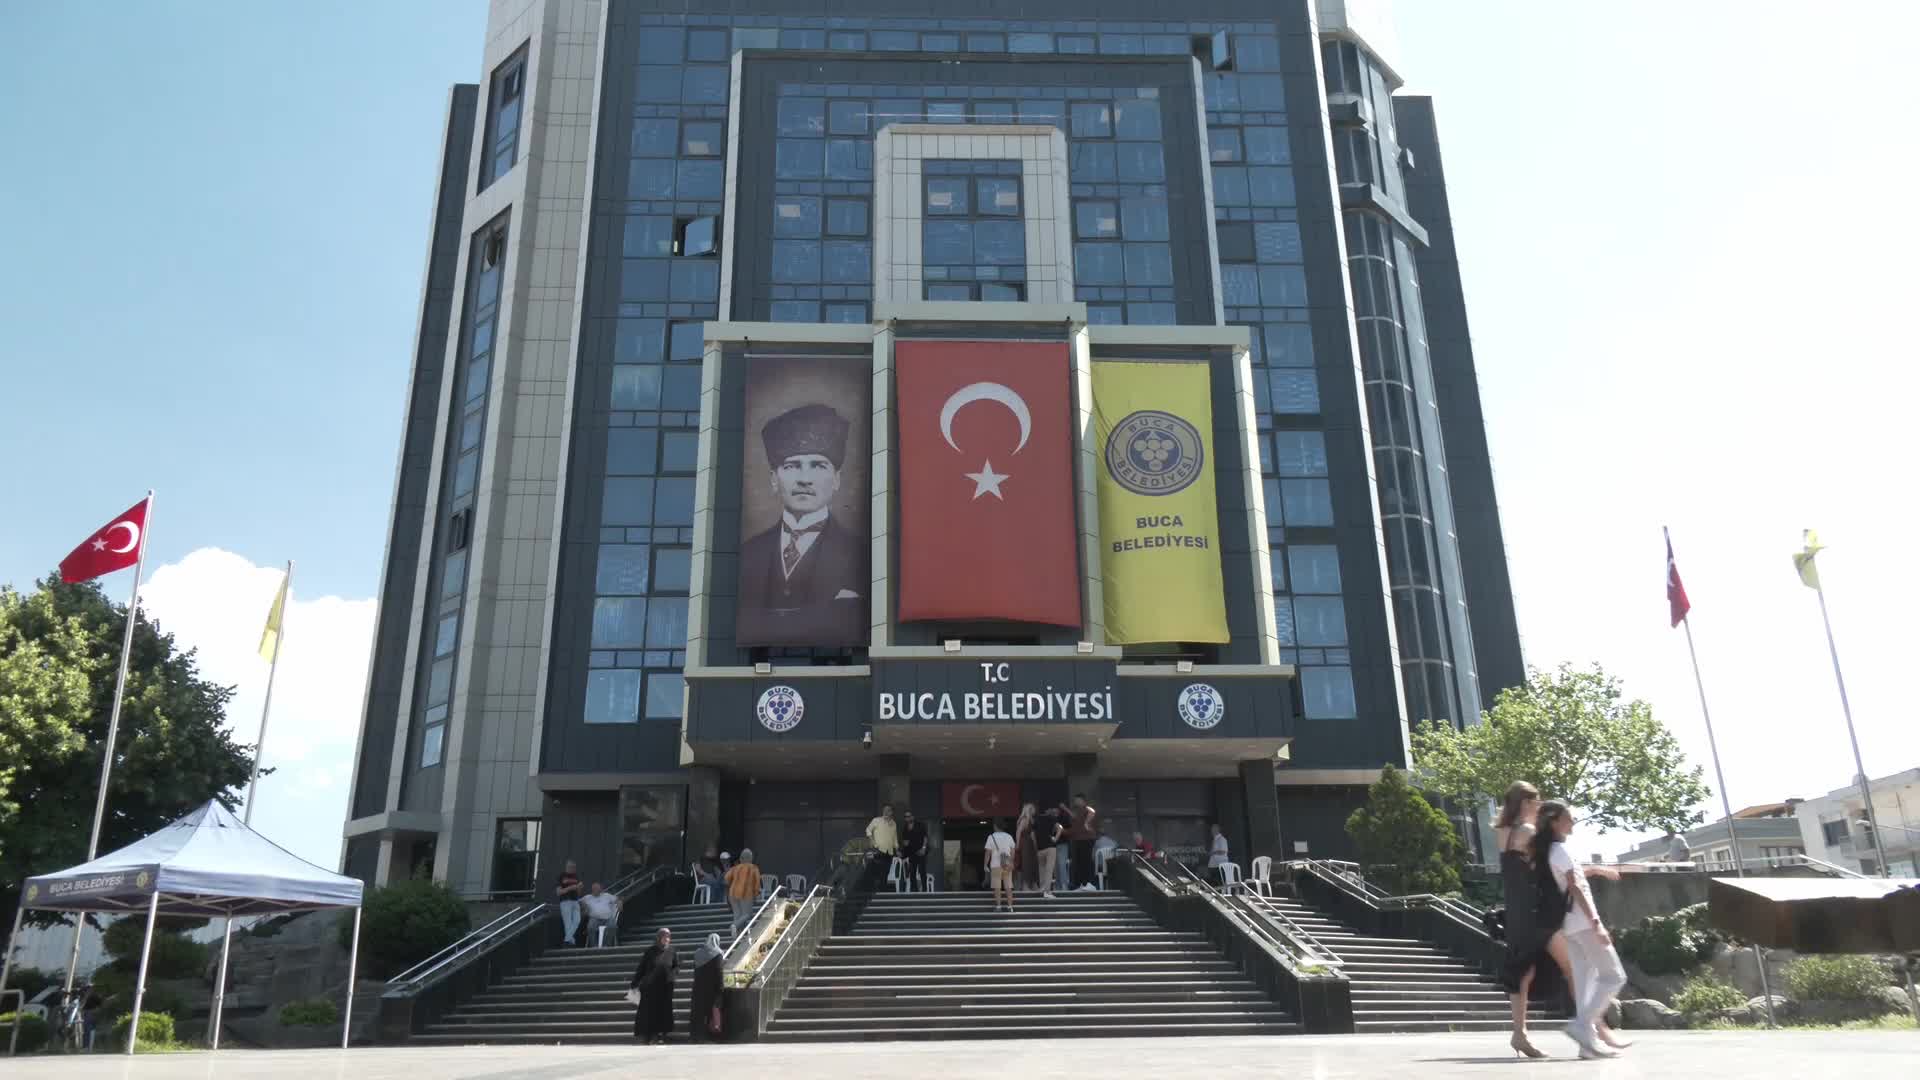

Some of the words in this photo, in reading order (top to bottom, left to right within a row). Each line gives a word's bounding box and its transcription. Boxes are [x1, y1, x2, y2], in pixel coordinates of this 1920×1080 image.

[1127, 418, 1178, 433] BUCA
[1136, 515, 1183, 529] BUCA
[1112, 533, 1208, 553] BELEDİYESİ
[980, 662, 1010, 682] T.C
[879, 692, 956, 720] BUCA
[964, 686, 1113, 720] BELEDİYESİ
